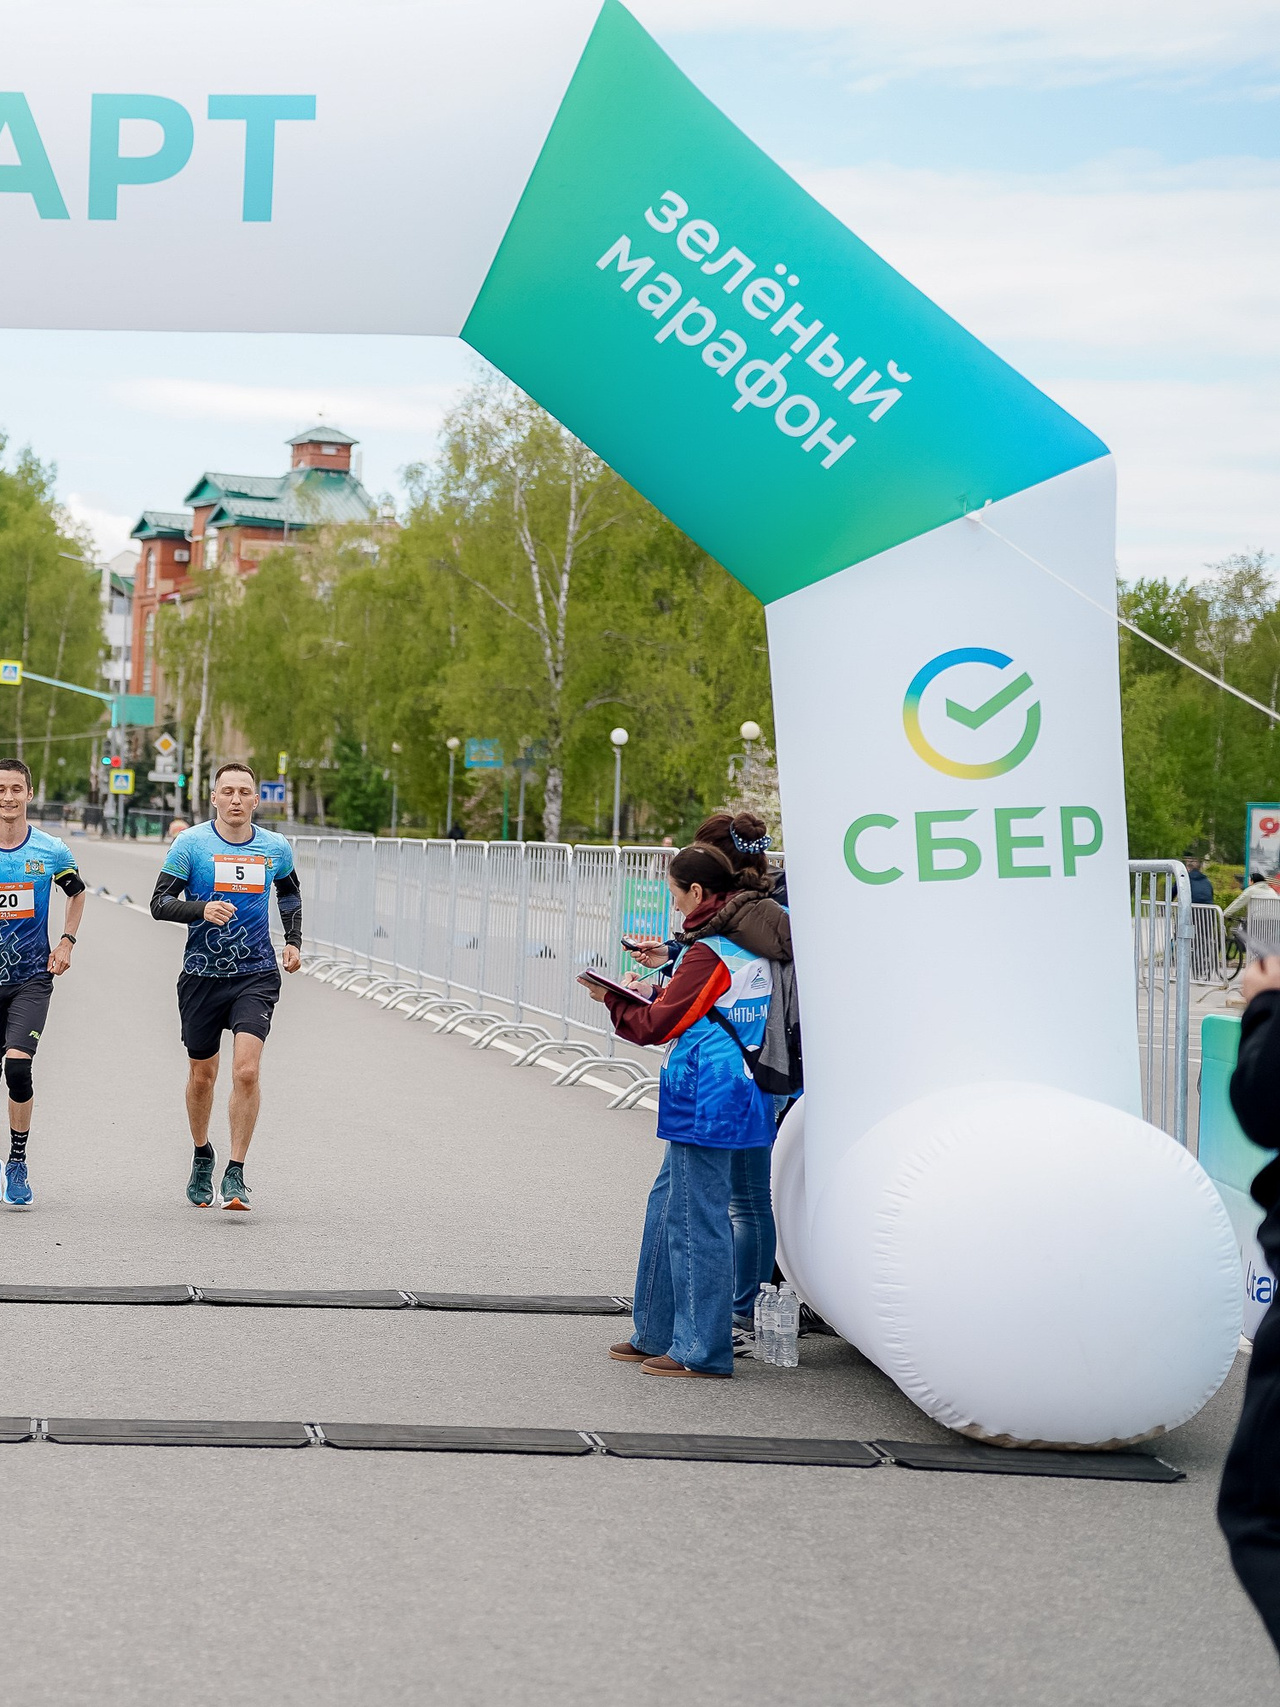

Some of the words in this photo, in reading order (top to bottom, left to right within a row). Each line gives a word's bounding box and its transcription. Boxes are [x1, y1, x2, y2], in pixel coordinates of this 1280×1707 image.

[595, 234, 857, 470] марафон
[644, 189, 913, 423] зелёный
[235, 865, 245, 881] 5
[843, 805, 1104, 886] СБЕР
